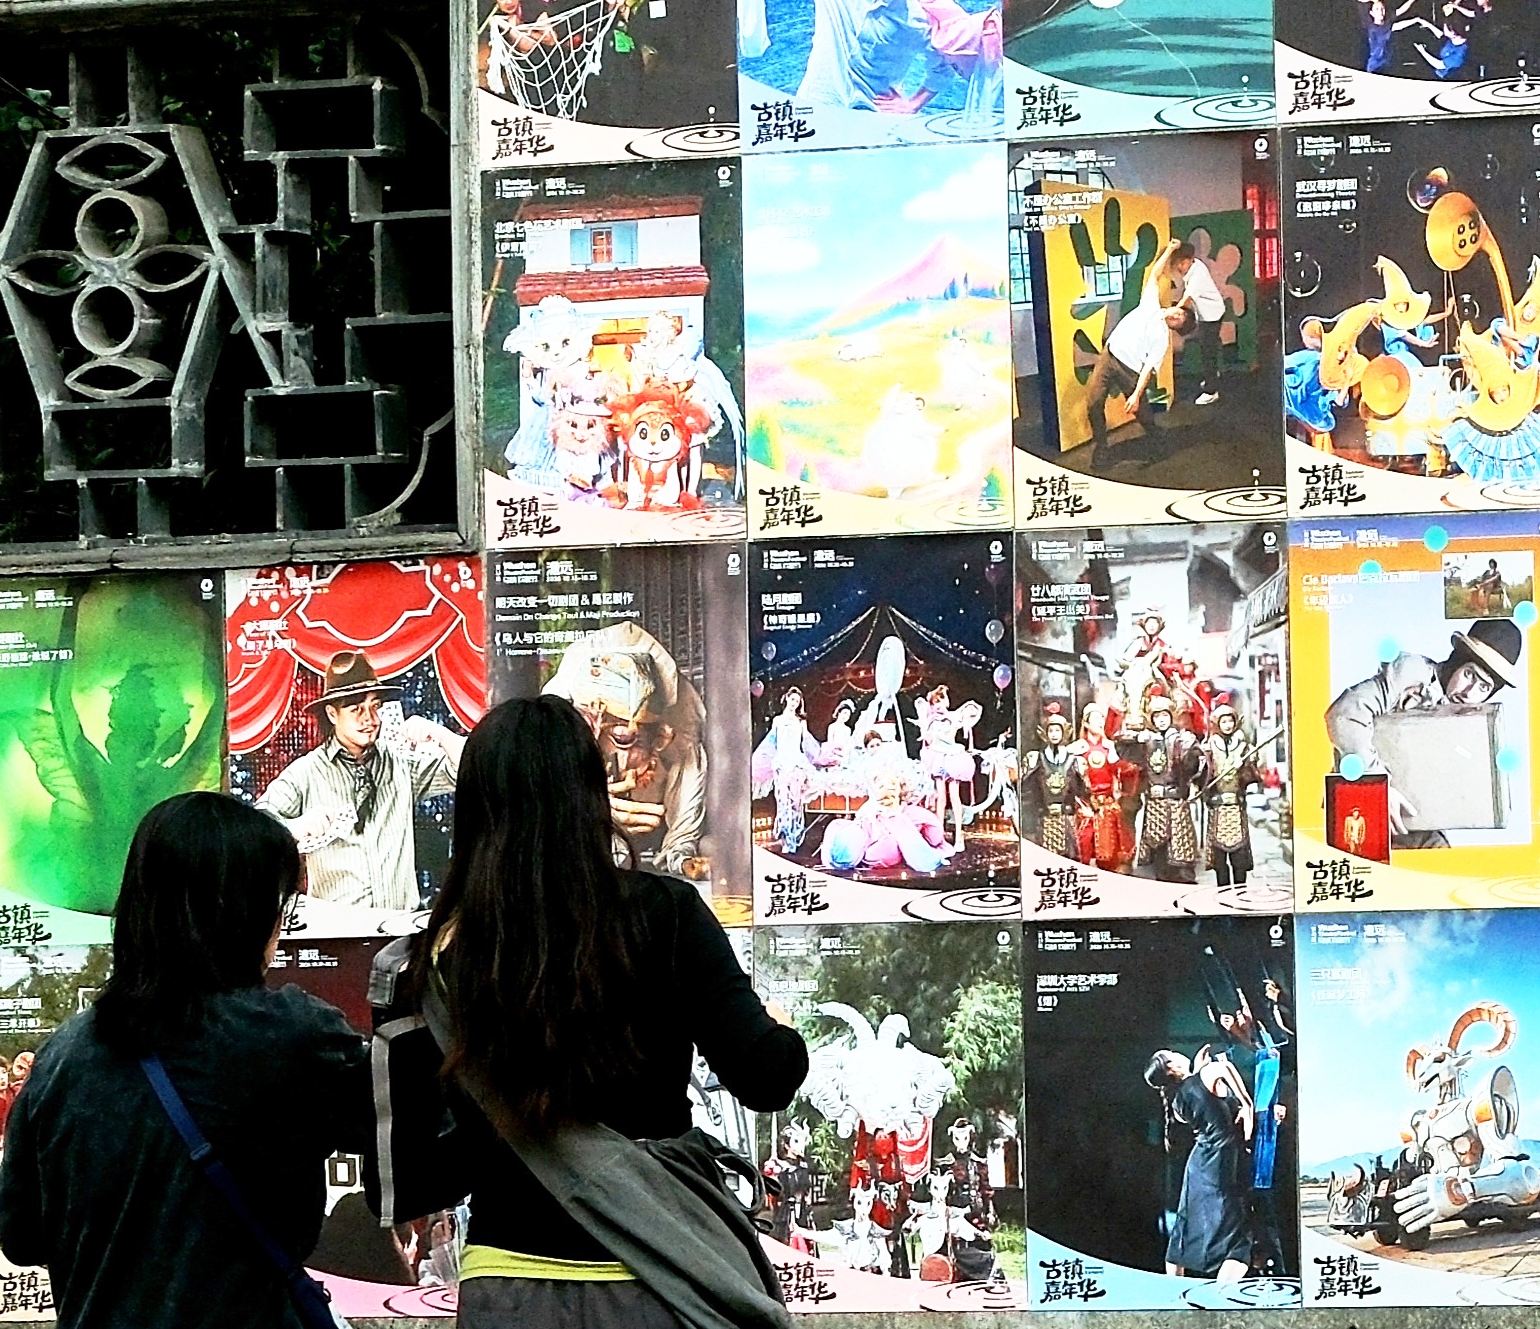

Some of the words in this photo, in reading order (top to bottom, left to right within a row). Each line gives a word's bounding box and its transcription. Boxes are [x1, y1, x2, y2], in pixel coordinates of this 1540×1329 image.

[1015, 84, 1059, 107] 古镇
[490, 115, 532, 137] 古镇
[1016, 103, 1082, 130] 嘉年华
[492, 134, 555, 159] 嘉年华
[1299, 464, 1343, 486] 古镇
[758, 485, 800, 507] 古镇
[1300, 483, 1366, 509] 嘉年华
[760, 504, 823, 530] 嘉年华
[1034, 867, 1078, 889] 古镇
[1035, 886, 1101, 912] 嘉年华
[1039, 1259, 1083, 1280] 古镇
[1040, 1279, 1106, 1303] 嘉年华
